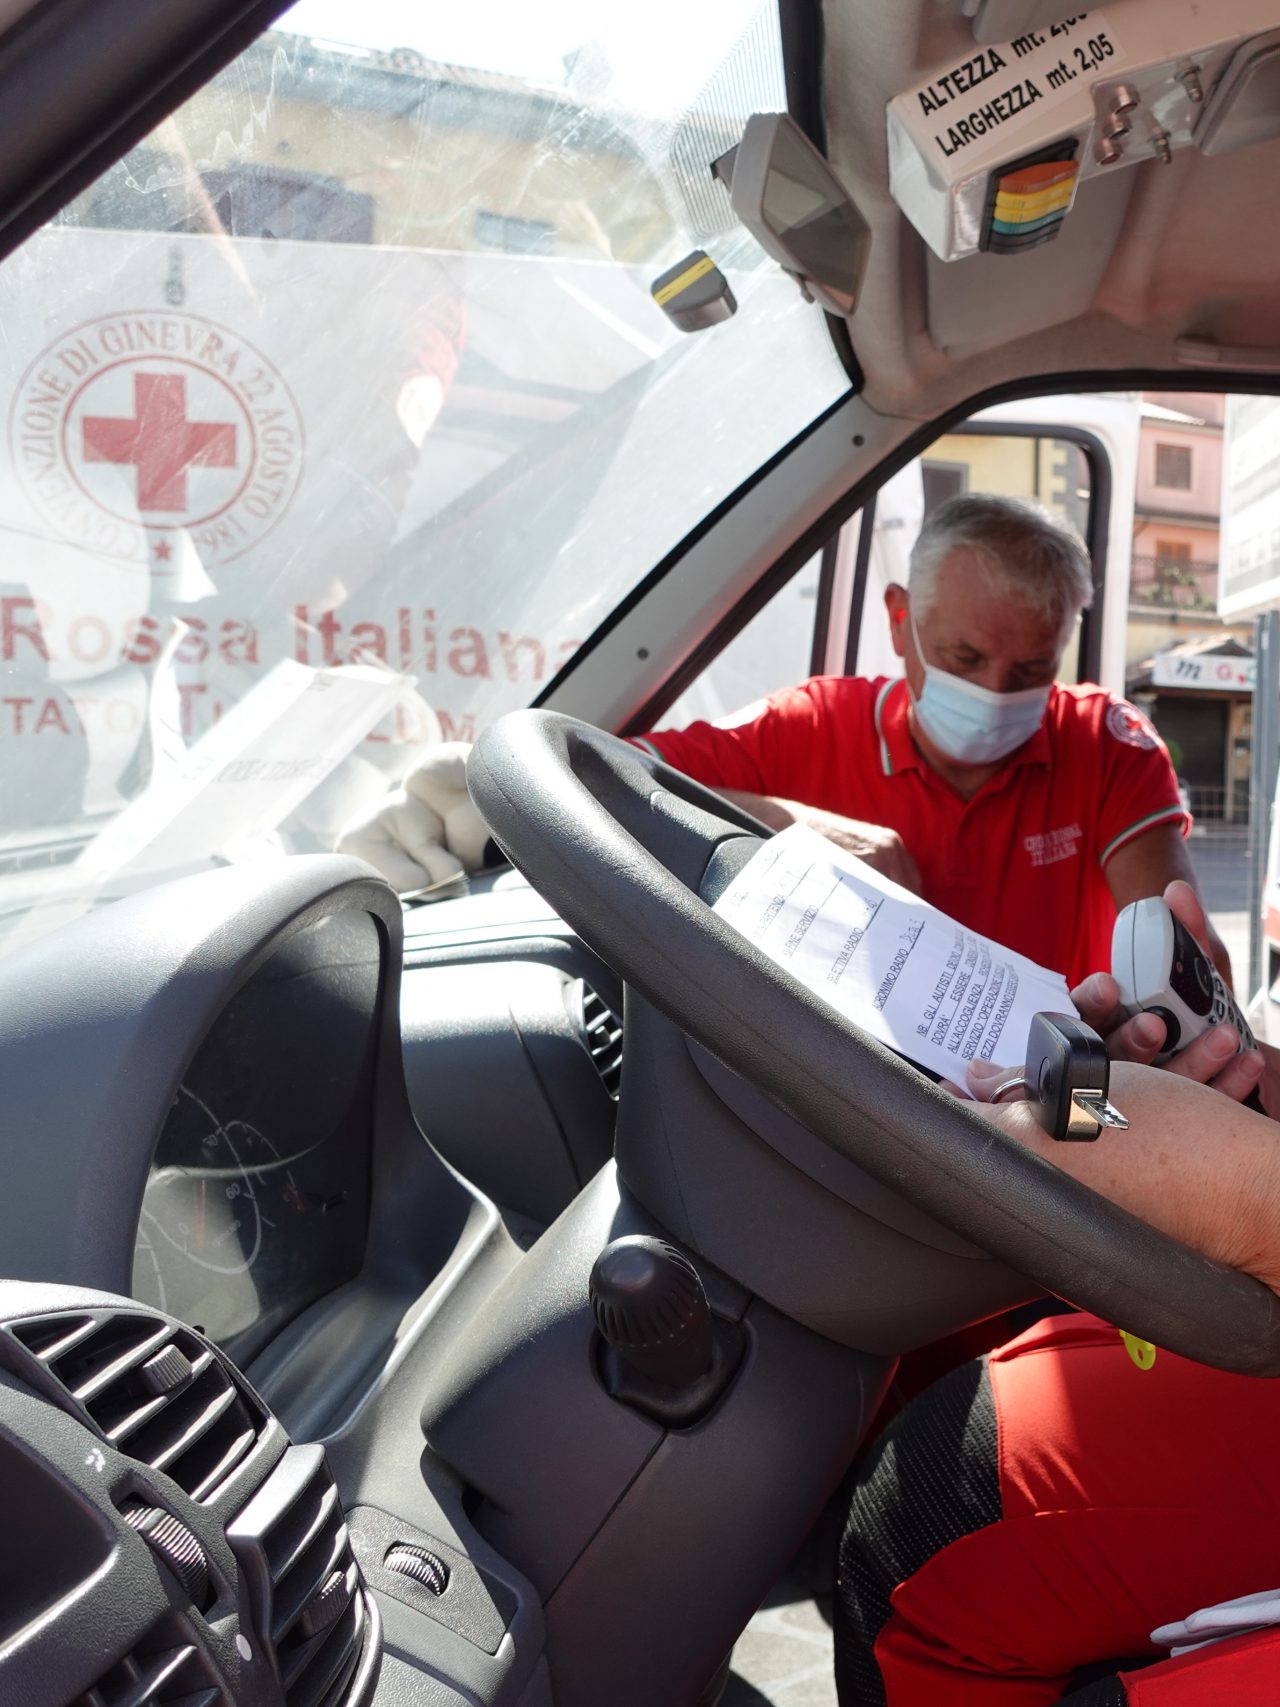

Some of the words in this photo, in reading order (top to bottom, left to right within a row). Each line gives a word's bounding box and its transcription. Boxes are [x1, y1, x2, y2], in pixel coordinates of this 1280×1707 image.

[917, 48, 1007, 116] ALTEZZA
[934, 79, 1043, 157] LARGHEZZA
[1045, 60, 1078, 89] mt.
[1073, 33, 1114, 70] 2,05
[57, 337, 99, 376] DI
[98, 319, 241, 376] GINEVRA
[238, 366, 277, 404] 22
[241, 407, 295, 520] AGOSTO
[191, 513, 248, 554] 186
[2, 597, 259, 665] Rossa
[847, 928, 863, 952] RADIO
[892, 948, 909, 974] RADIO
[922, 1003, 936, 1020] GLI
[932, 970, 952, 1002] AUTISTI
[952, 972, 970, 1002] ESSERE
[988, 994, 1014, 1040] DOVRANNO
[962, 1022, 984, 1061] SERVIZIO
[226, 1183, 240, 1200] 60
